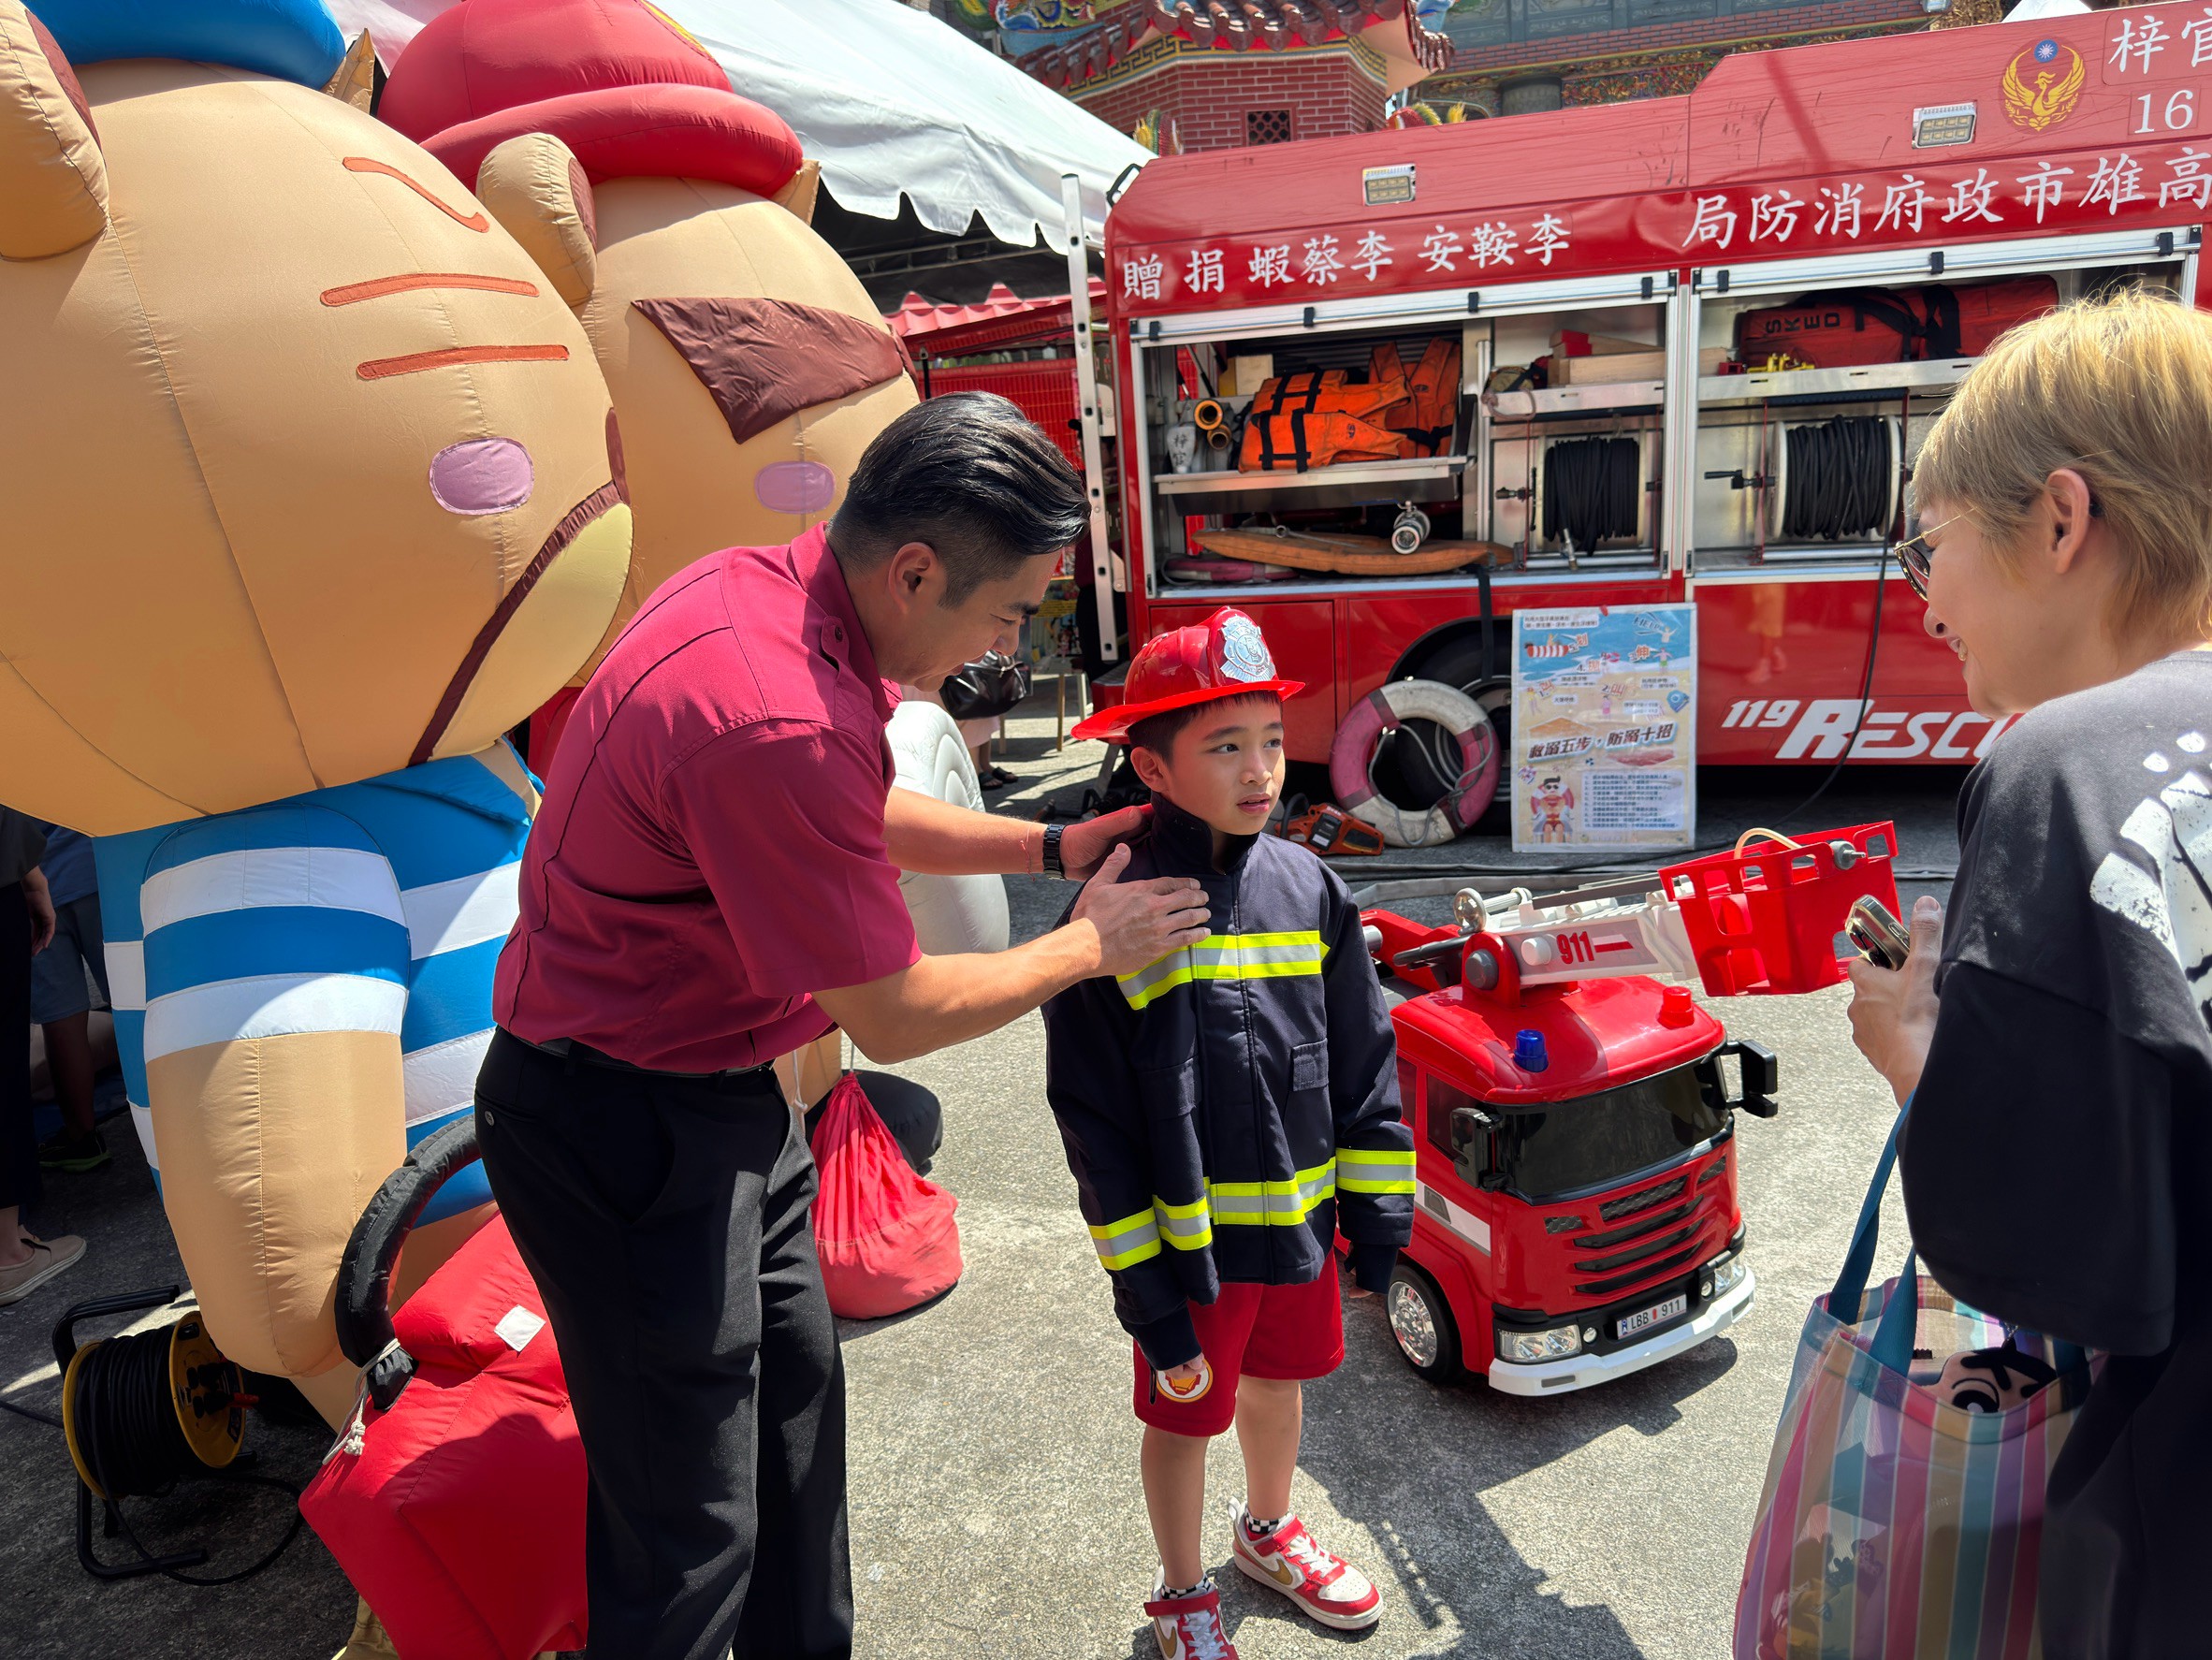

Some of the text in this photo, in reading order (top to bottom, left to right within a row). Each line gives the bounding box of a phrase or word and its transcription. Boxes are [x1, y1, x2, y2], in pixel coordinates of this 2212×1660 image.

[2134, 89, 2194, 134] 16
[1722, 700, 1801, 728] 119
[1556, 930, 1594, 965] 911
[1631, 1312, 1650, 1330] LBB
[1661, 1299, 1681, 1317] 911
